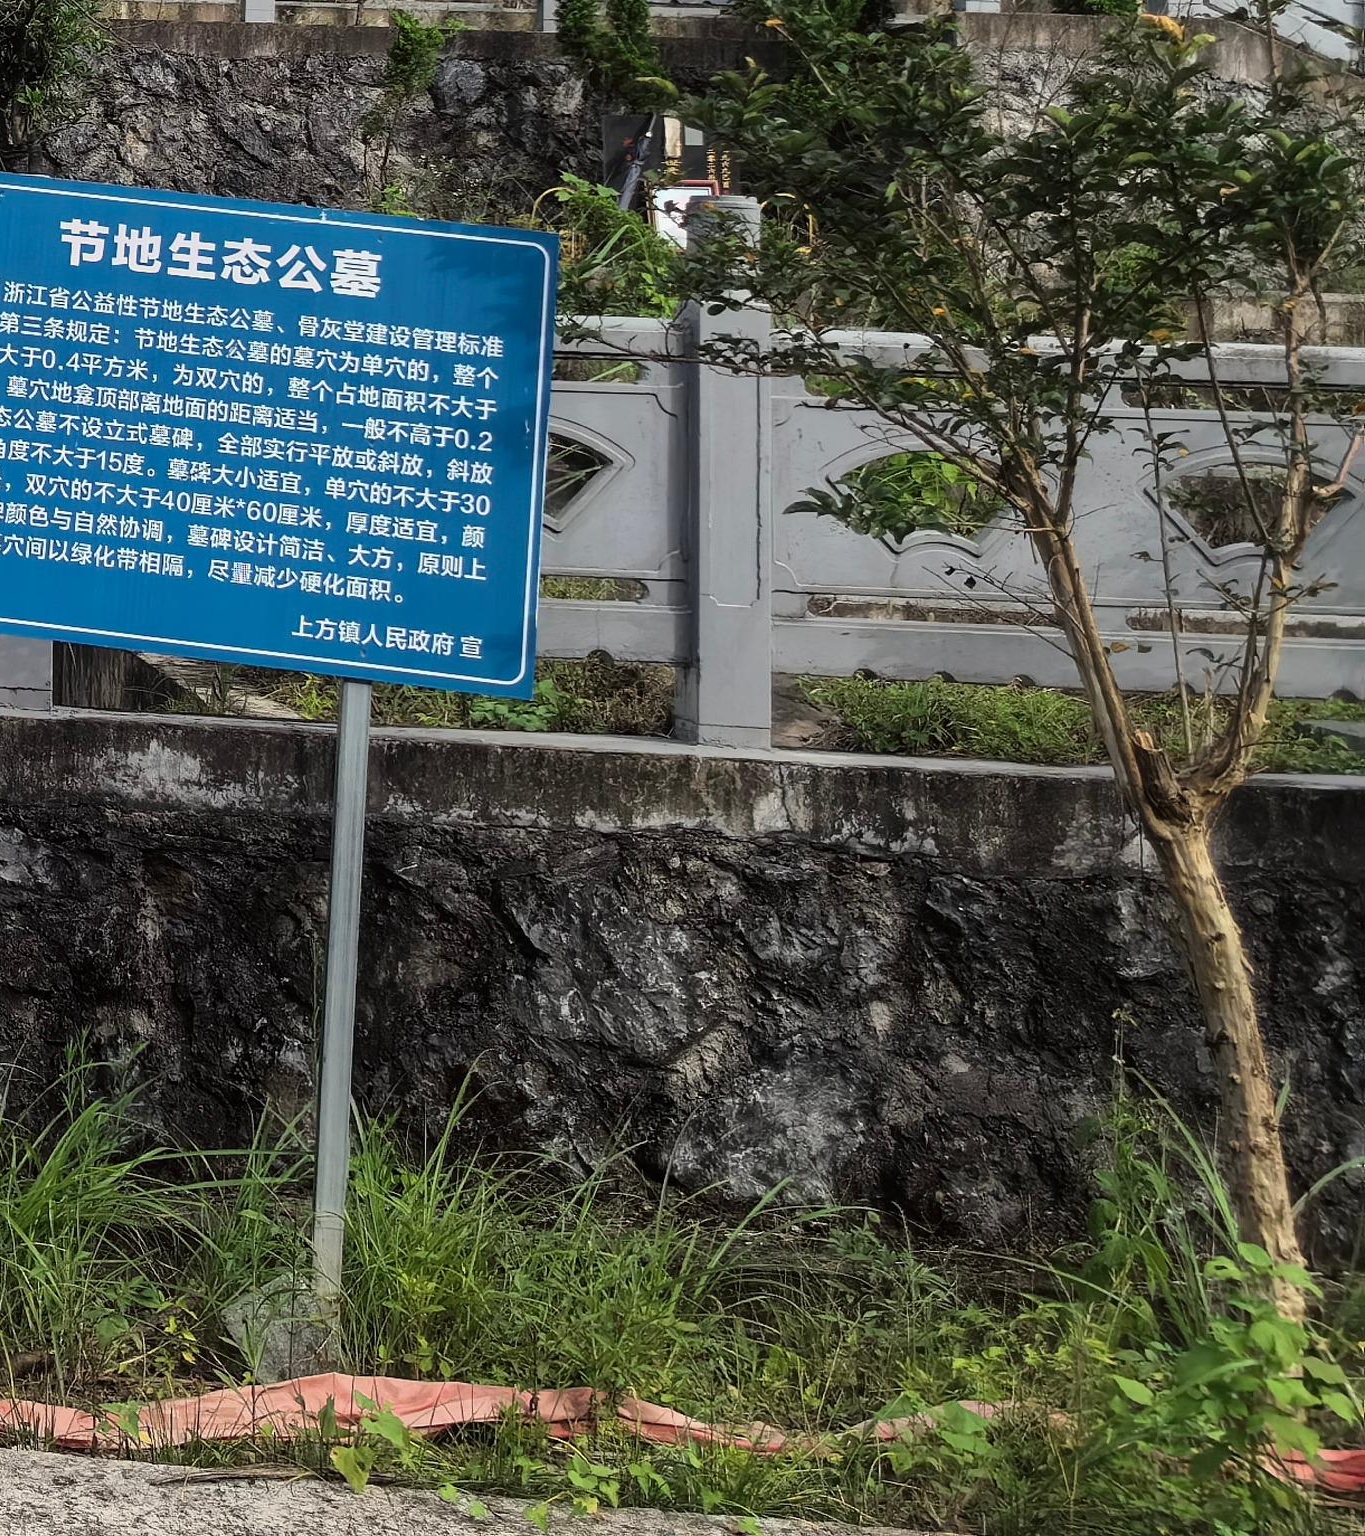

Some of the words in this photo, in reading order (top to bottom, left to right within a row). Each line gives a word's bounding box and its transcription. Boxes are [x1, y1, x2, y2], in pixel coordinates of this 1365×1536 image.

[58, 217, 383, 298] 节地生态公墓
[290, 614, 455, 656] 上方镇人民政府
[458, 634, 483, 659] 宣
